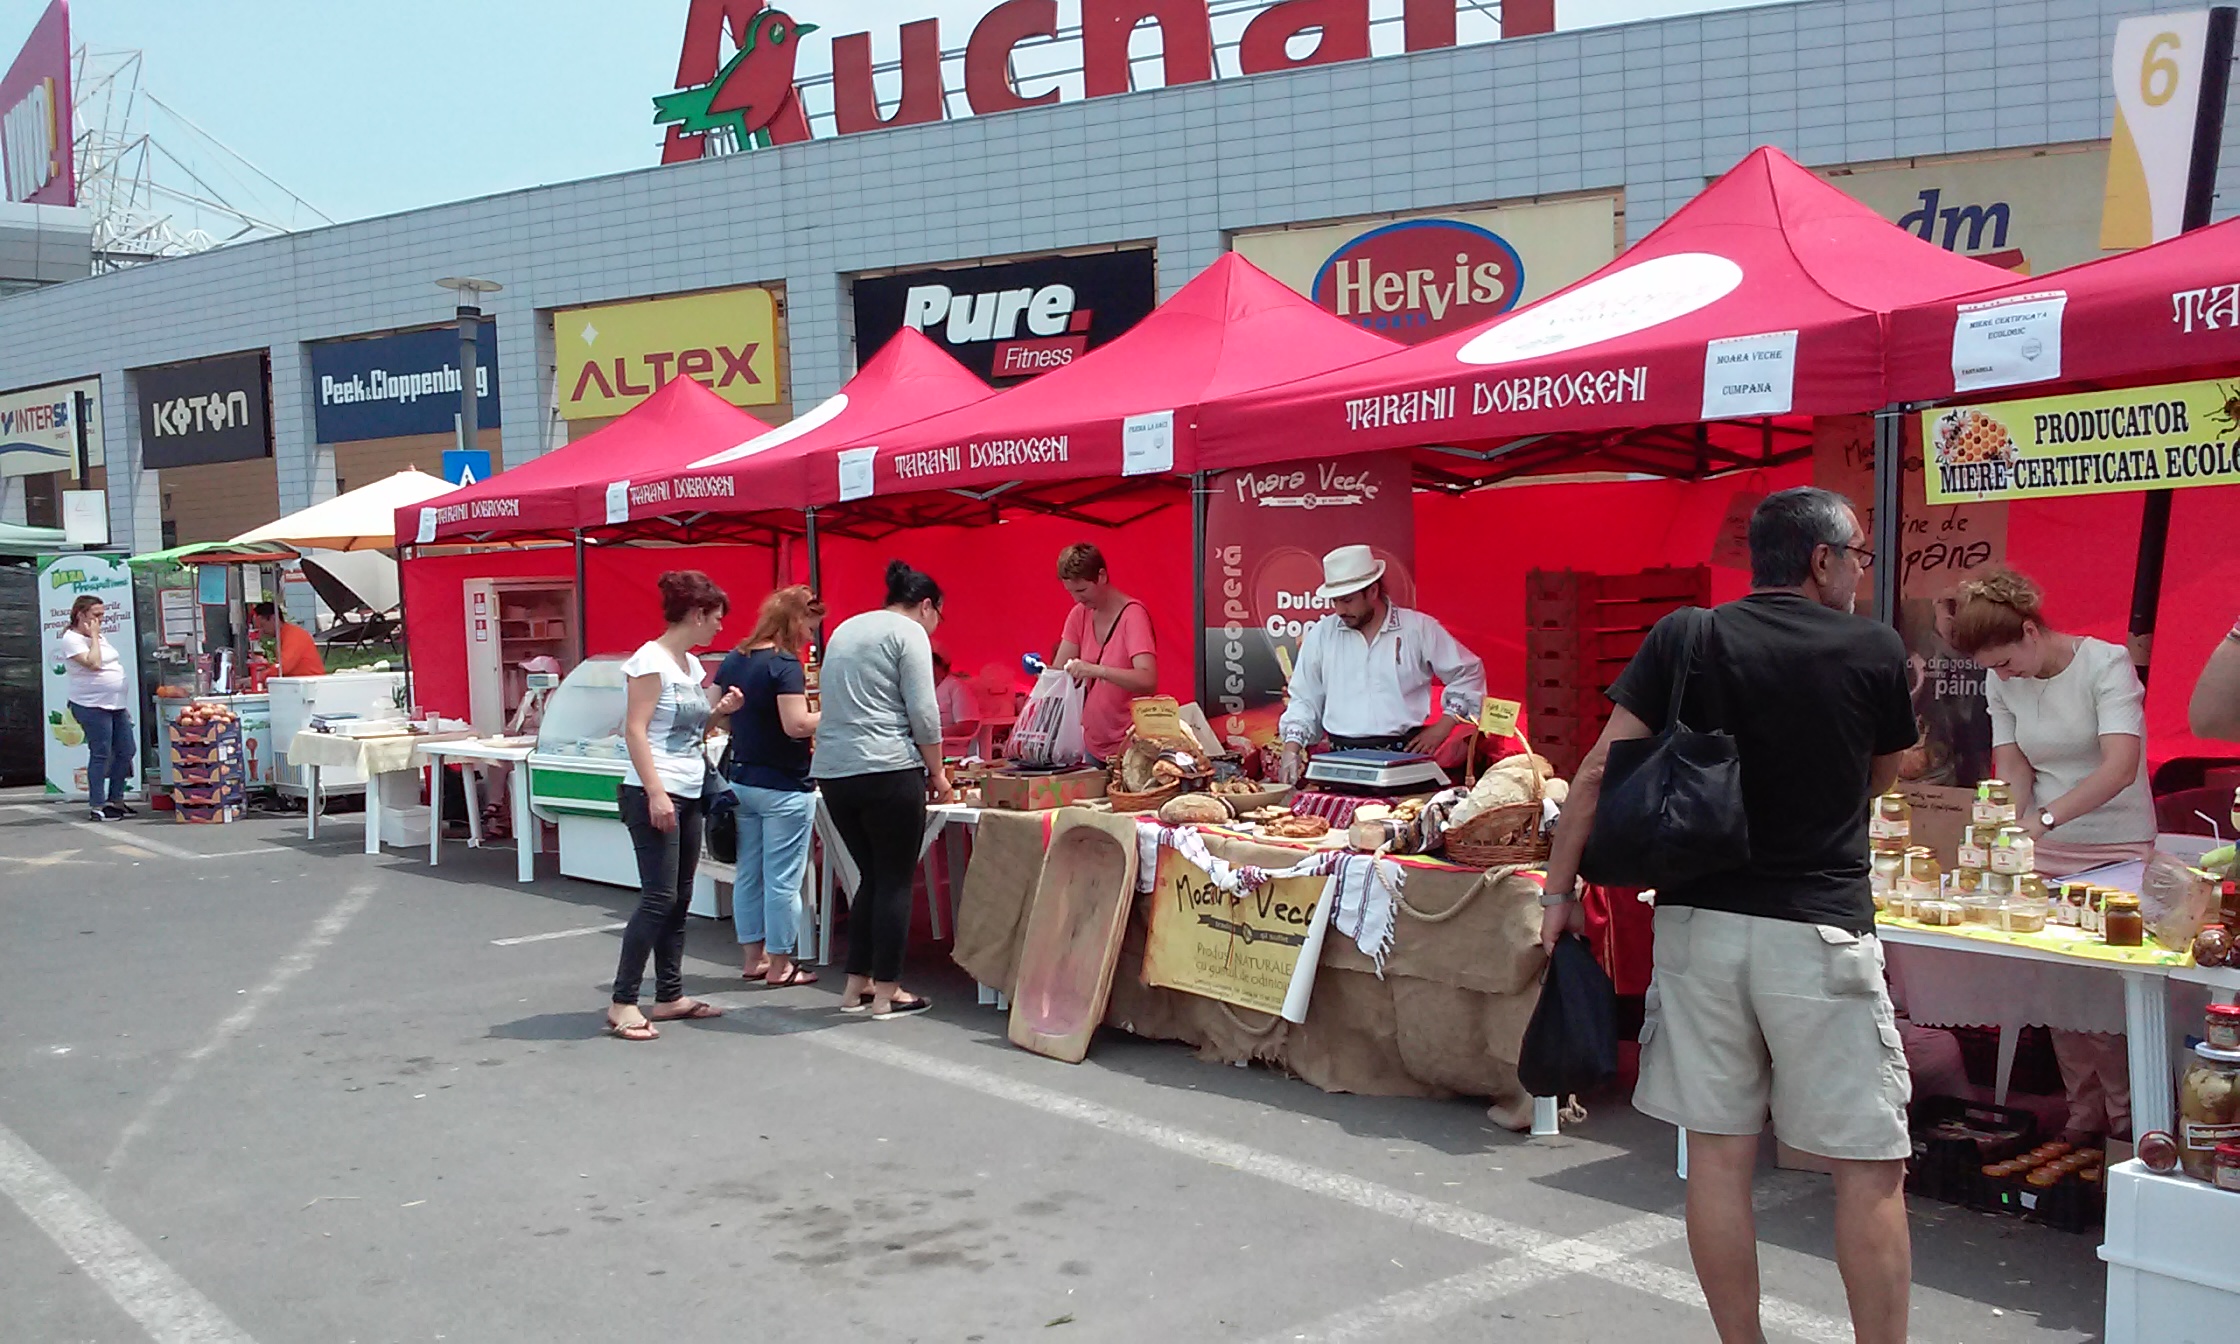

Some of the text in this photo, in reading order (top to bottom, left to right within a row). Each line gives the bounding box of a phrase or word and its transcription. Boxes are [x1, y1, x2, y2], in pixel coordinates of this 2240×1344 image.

[2140, 32, 2182, 107] 6
[1897, 189, 2011, 252] dm
[1335, 252, 1504, 321] Hervis
[1352, 313, 1428, 330] PORTS
[1969, 311, 2047, 329] MIERE CERTIFICATA
[1004, 346, 1073, 370] Fitness
[1716, 350, 1783, 364] MOARA VECHE
[1345, 366, 1648, 431] TARANII DOBROGENI
[1722, 383, 1772, 396] CUMPANA
[2034, 401, 2189, 445] PRODUCATOR
[970, 435, 1068, 469] DOBROGENI
[1236, 462, 1379, 503] Moara Veche
[1940, 461, 2008, 494] MIERE
[2014, 449, 2160, 489] CERTIFICATA
[674, 475, 735, 499] DOBROGENI
[1942, 505, 1969, 532] de
[1234, 952, 1293, 977] NATURALE
